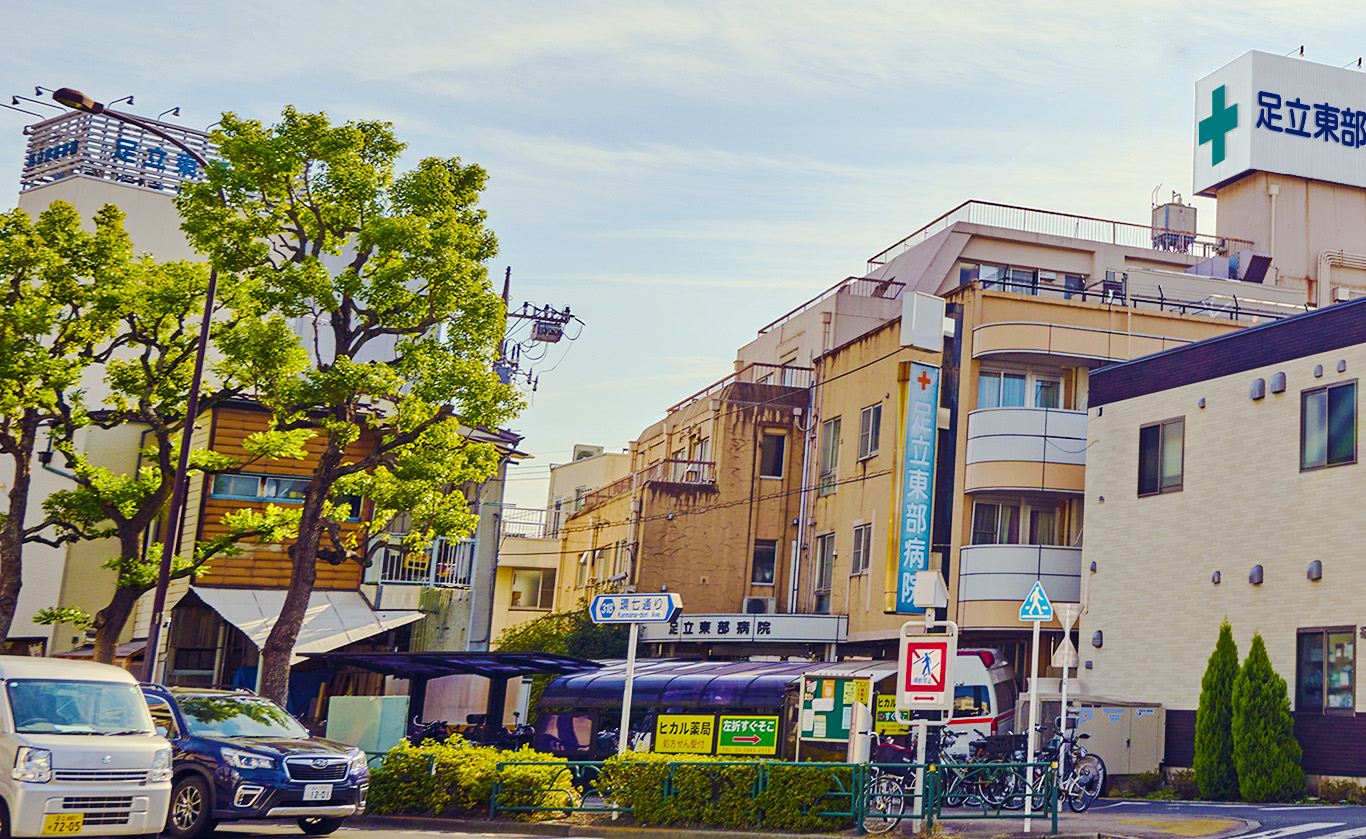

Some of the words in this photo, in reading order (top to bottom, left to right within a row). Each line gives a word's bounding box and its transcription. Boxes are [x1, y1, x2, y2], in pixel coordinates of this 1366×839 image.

[620, 598, 662, 611] 環七通り
[668, 620, 771, 636] 足立東部病院
[659, 721, 711, 736] ヒカル薬局
[722, 720, 775, 732] 左折すぐそこ
[662, 739, 705, 749] 処方せん受付
[53, 821, 81, 832] 72-05
